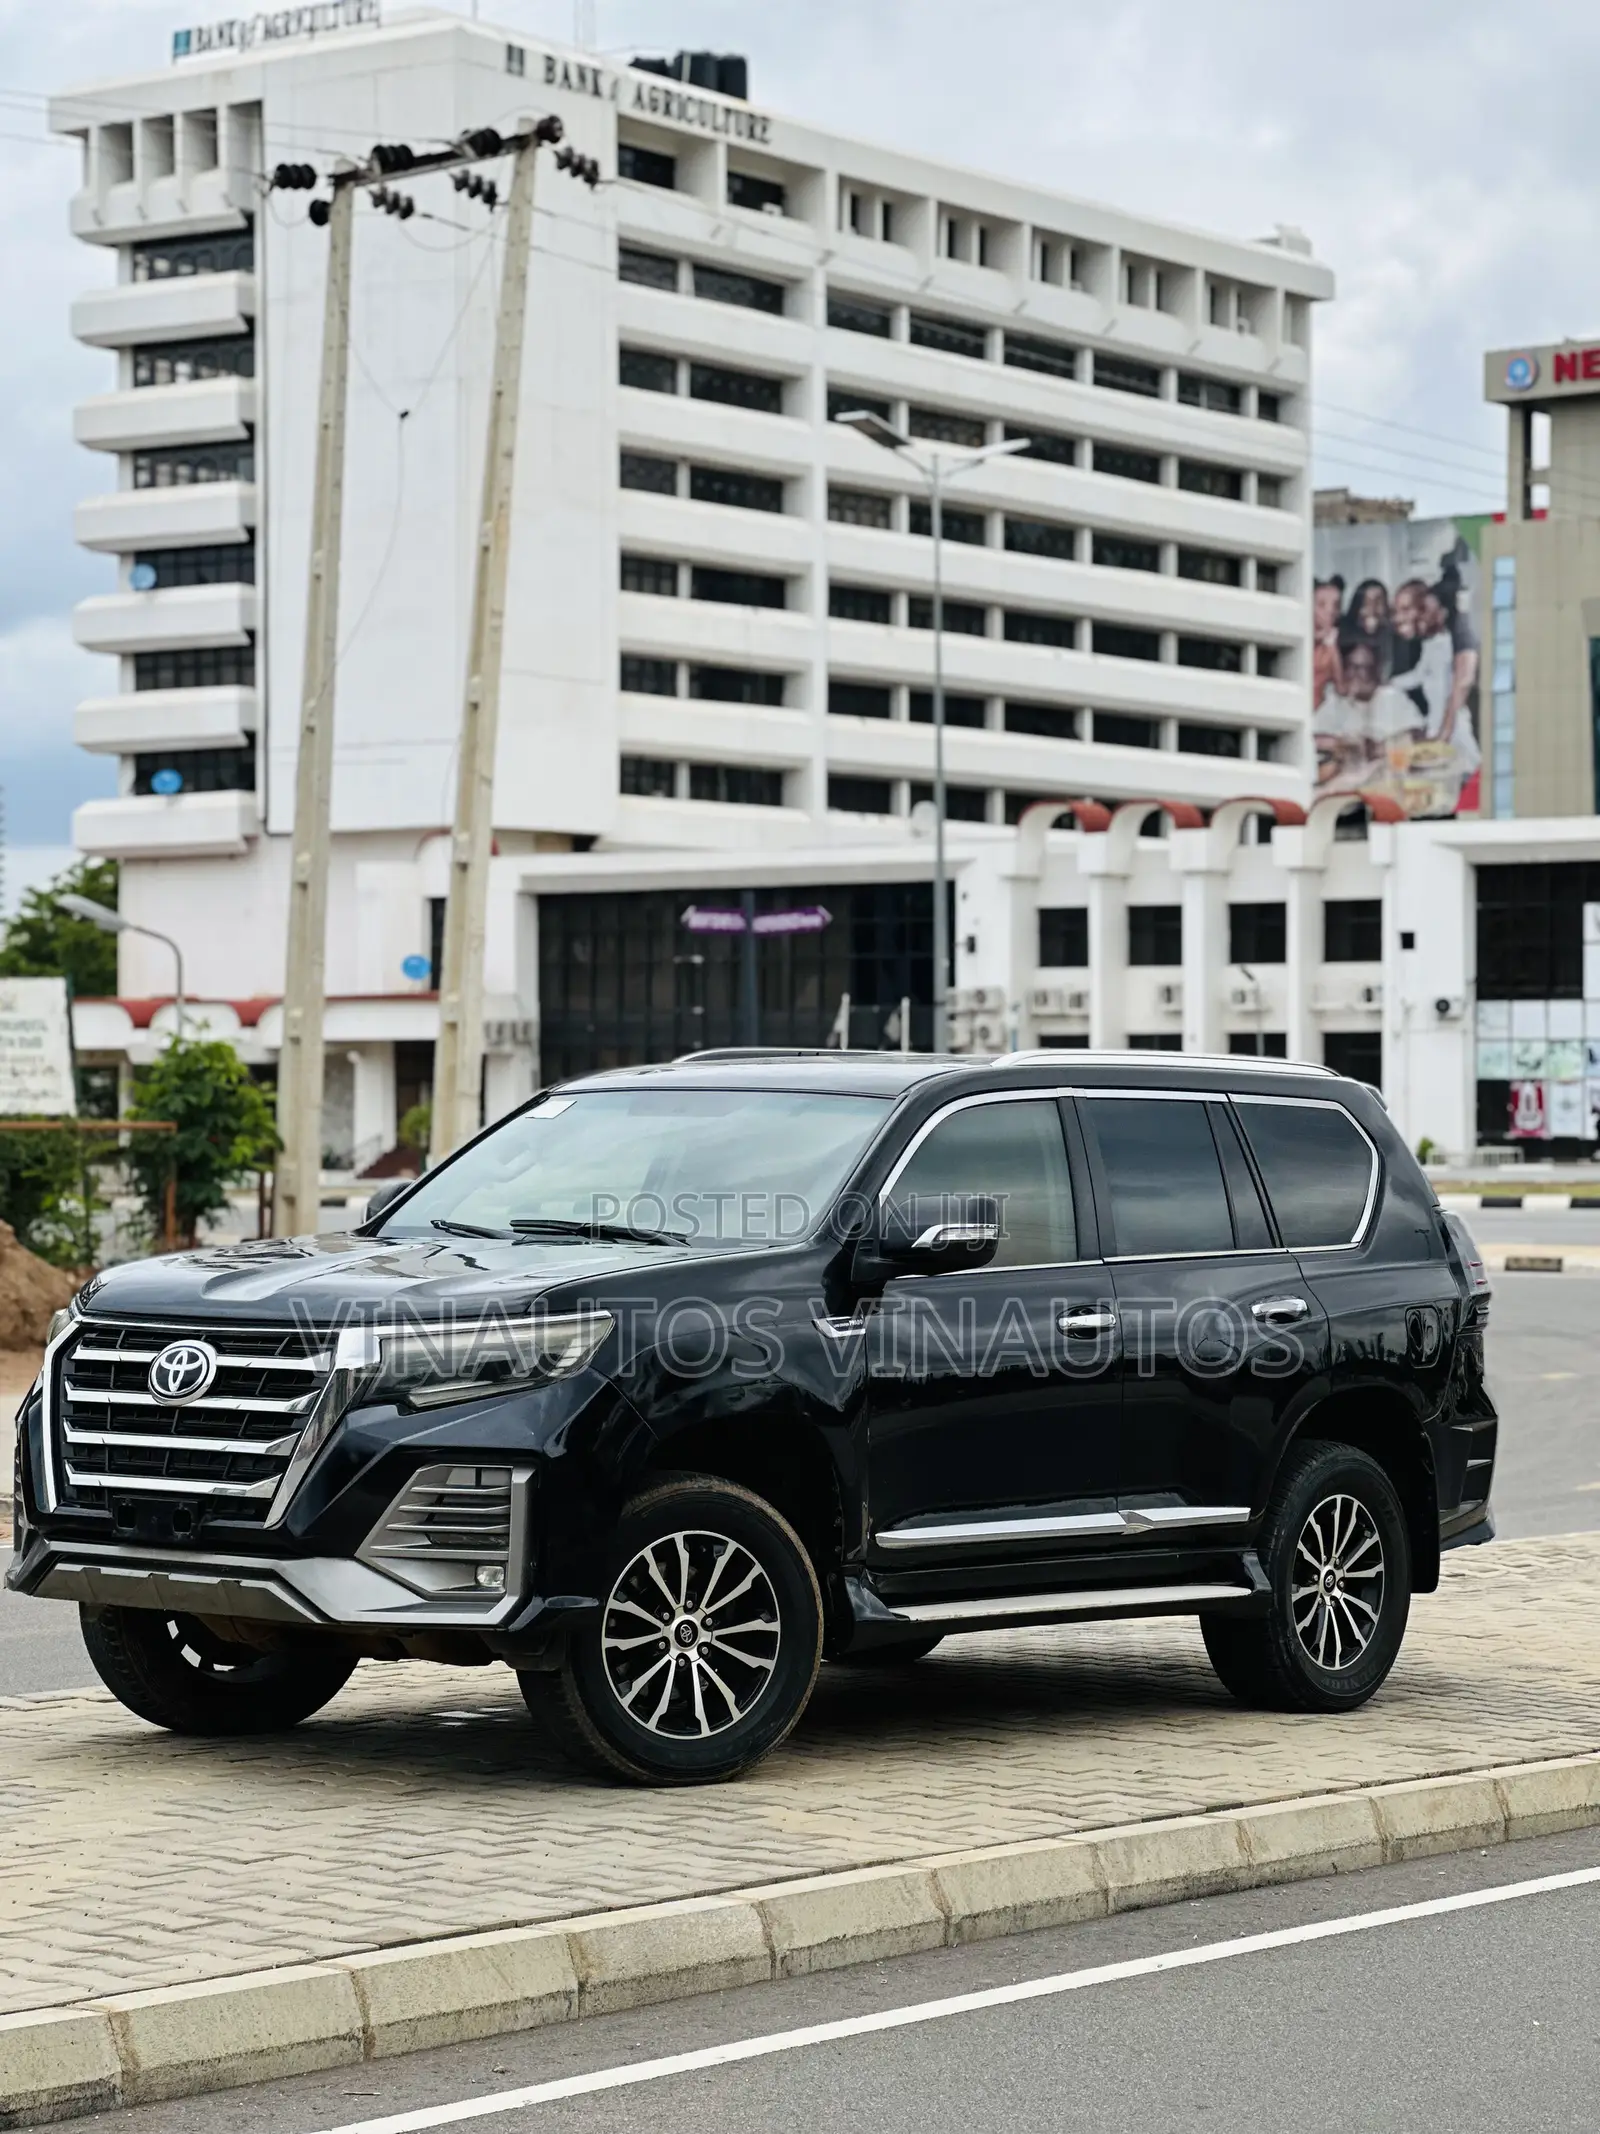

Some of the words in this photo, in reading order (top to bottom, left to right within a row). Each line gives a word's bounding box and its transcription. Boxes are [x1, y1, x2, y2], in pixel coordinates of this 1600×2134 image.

[194, 20, 237, 52] BANK
[544, 54, 602, 98] BANK
[632, 82, 771, 144] AGRICULTURE
